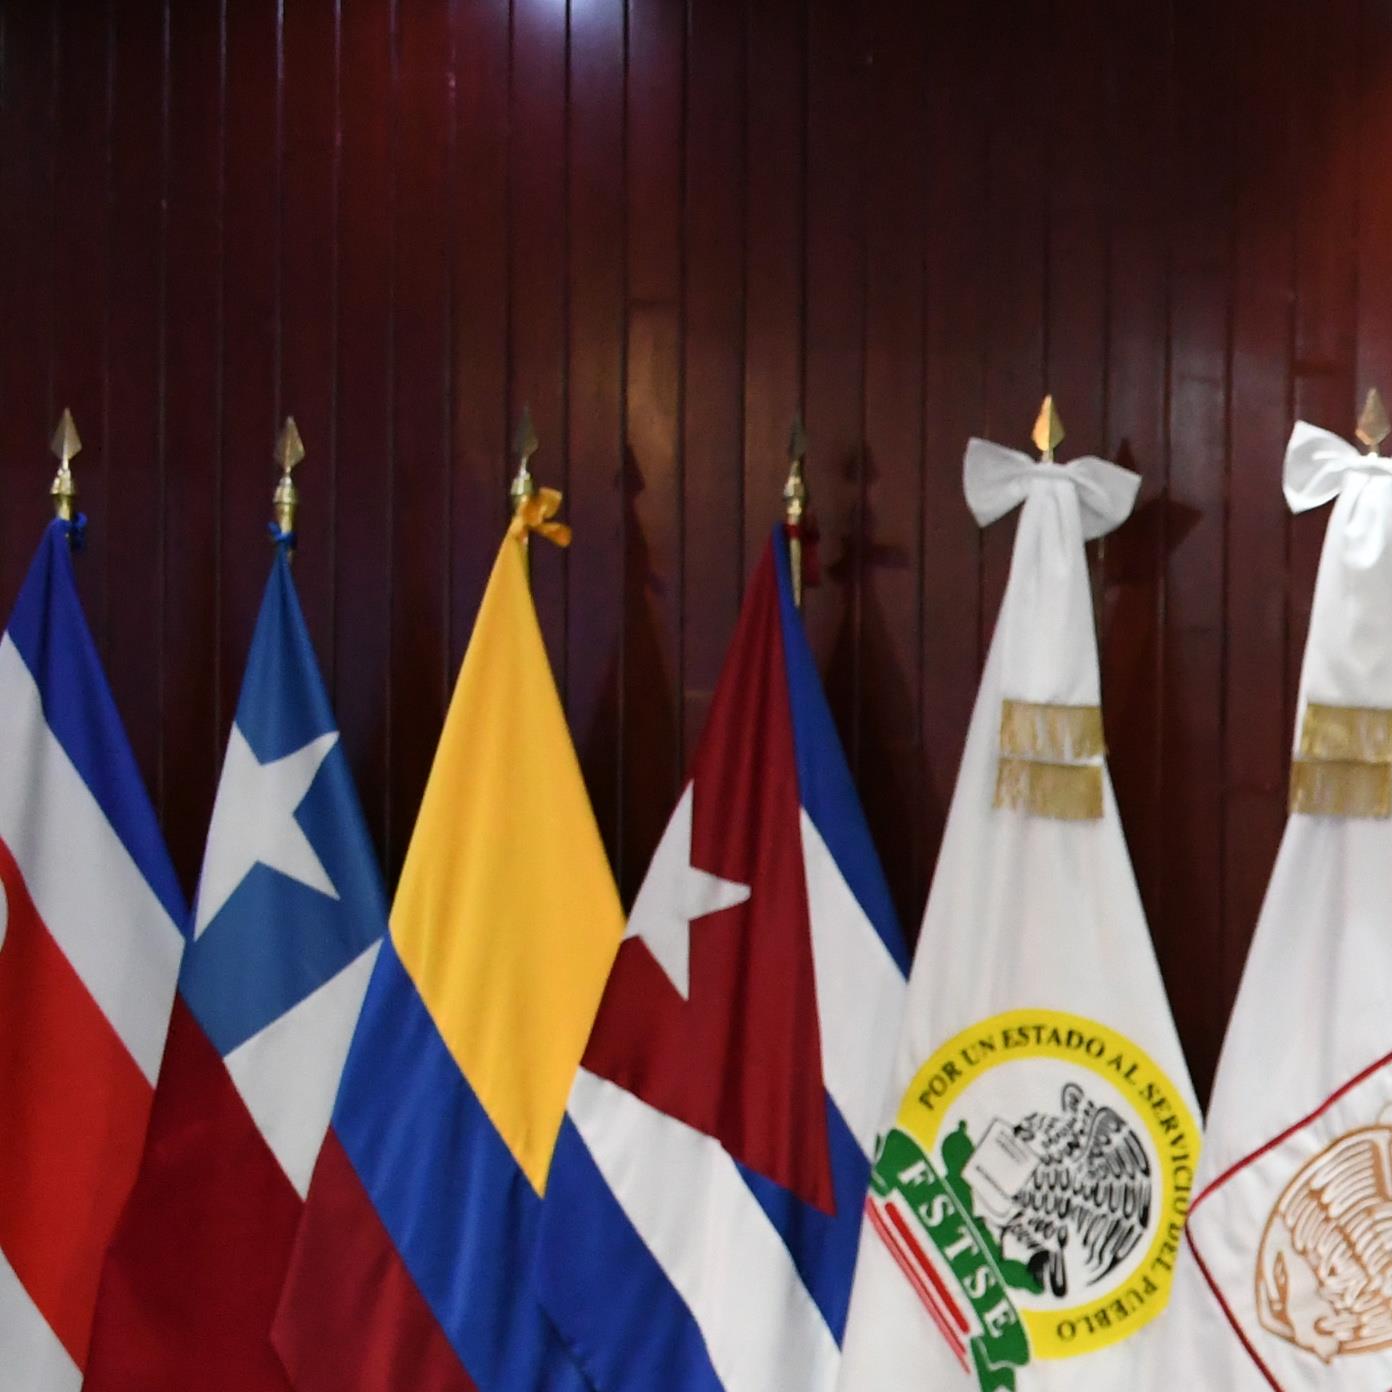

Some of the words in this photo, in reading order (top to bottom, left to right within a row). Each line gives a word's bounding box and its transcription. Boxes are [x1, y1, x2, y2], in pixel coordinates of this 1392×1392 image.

[960, 1035, 998, 1068] UN
[1001, 1023, 1106, 1059] ESTADO
[918, 1059, 963, 1112] POR
[1107, 1052, 1137, 1087] AL
[1138, 1080, 1194, 1217] SERVICIO
[898, 1160, 1018, 1340] FSTSE
[1153, 1223, 1183, 1273] DEL
[1055, 1274, 1159, 1341] PUEBLO
